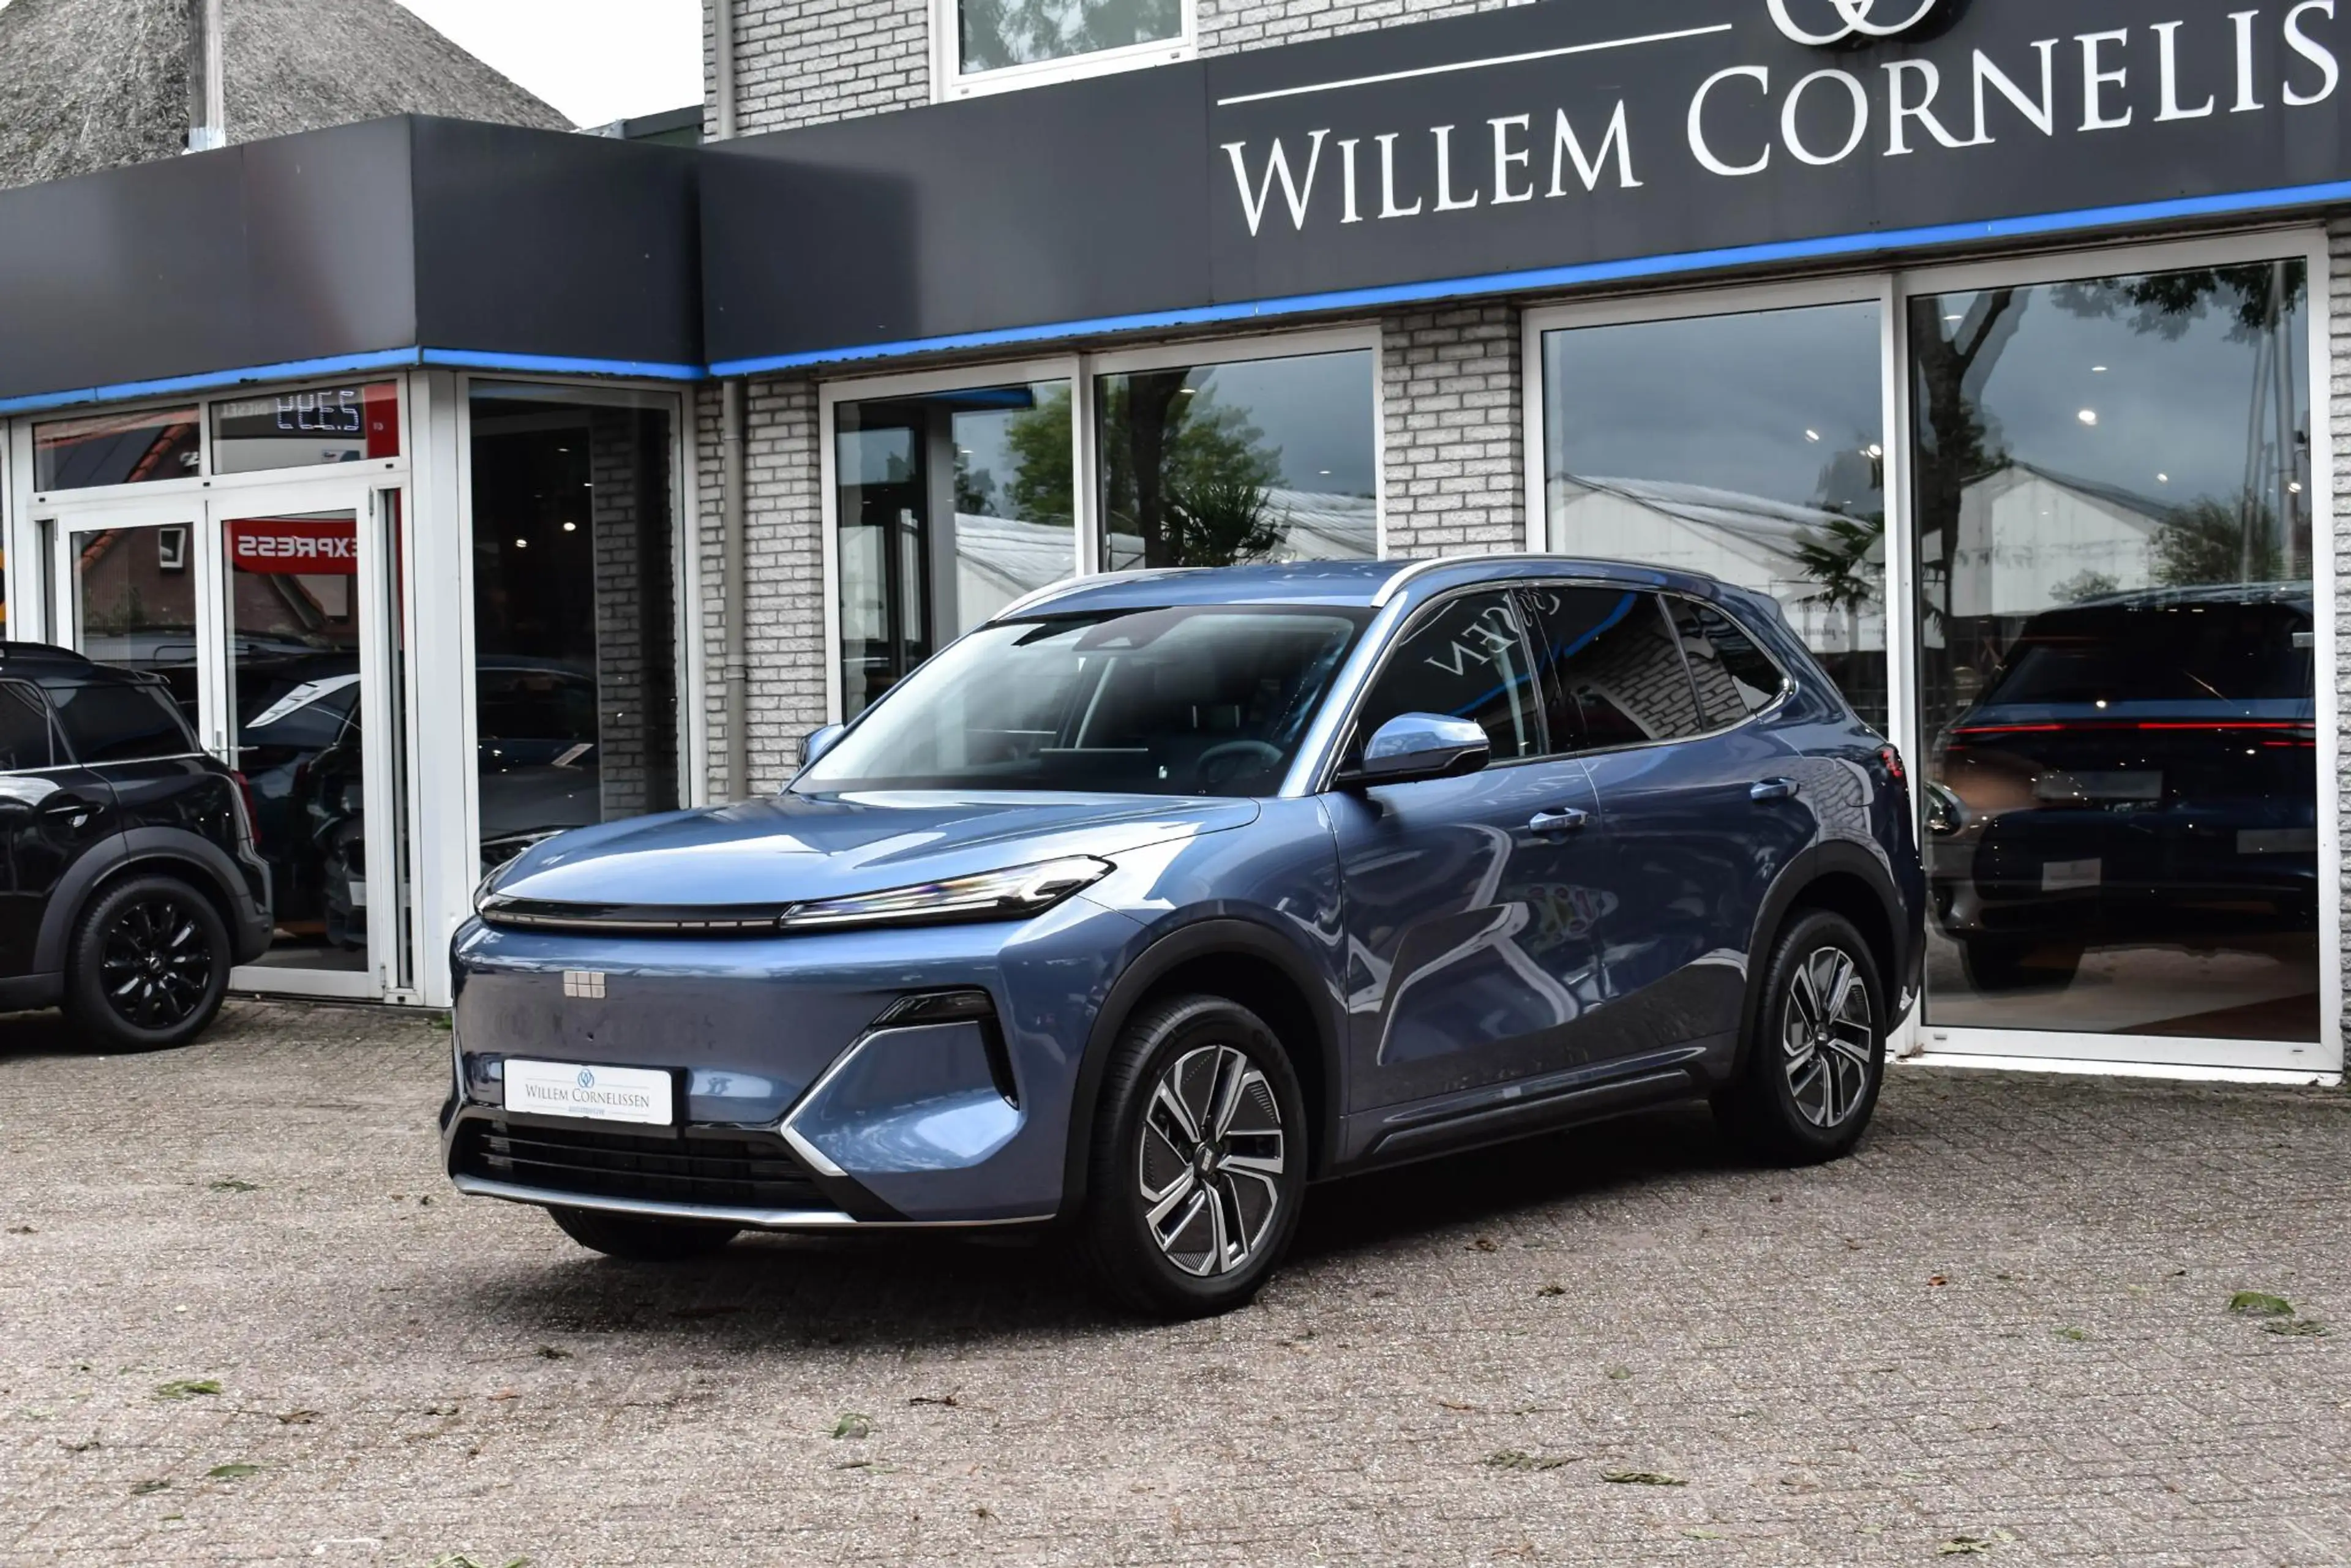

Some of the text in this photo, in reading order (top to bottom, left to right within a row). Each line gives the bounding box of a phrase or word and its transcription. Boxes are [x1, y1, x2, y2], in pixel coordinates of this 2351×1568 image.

[1220, 0, 2339, 238] WILLEM CORNELIS
[525, 1084, 650, 1108] WILLEM CORNELISSEN
